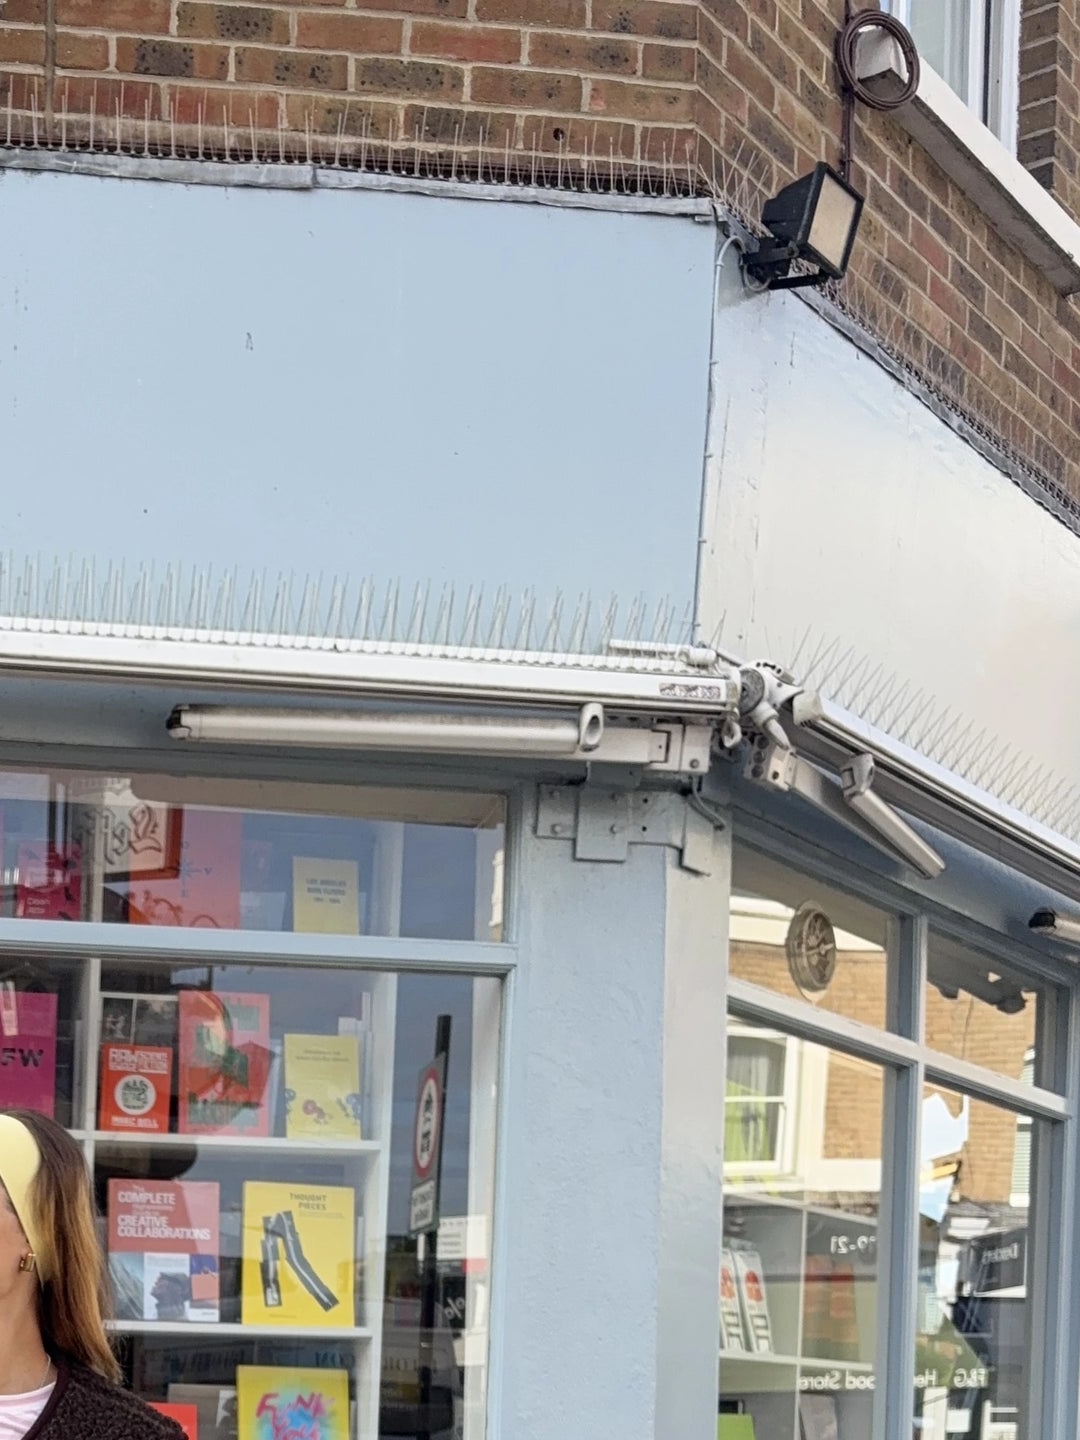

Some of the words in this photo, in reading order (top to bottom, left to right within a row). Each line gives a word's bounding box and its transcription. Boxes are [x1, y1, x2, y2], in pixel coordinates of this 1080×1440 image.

[118, 1191, 176, 1205] COMPLETE
[290, 1192, 327, 1202] THOUGHT
[117, 1215, 168, 1228] CREATIVE
[117, 1226, 211, 1241] COLLABORATIONS
